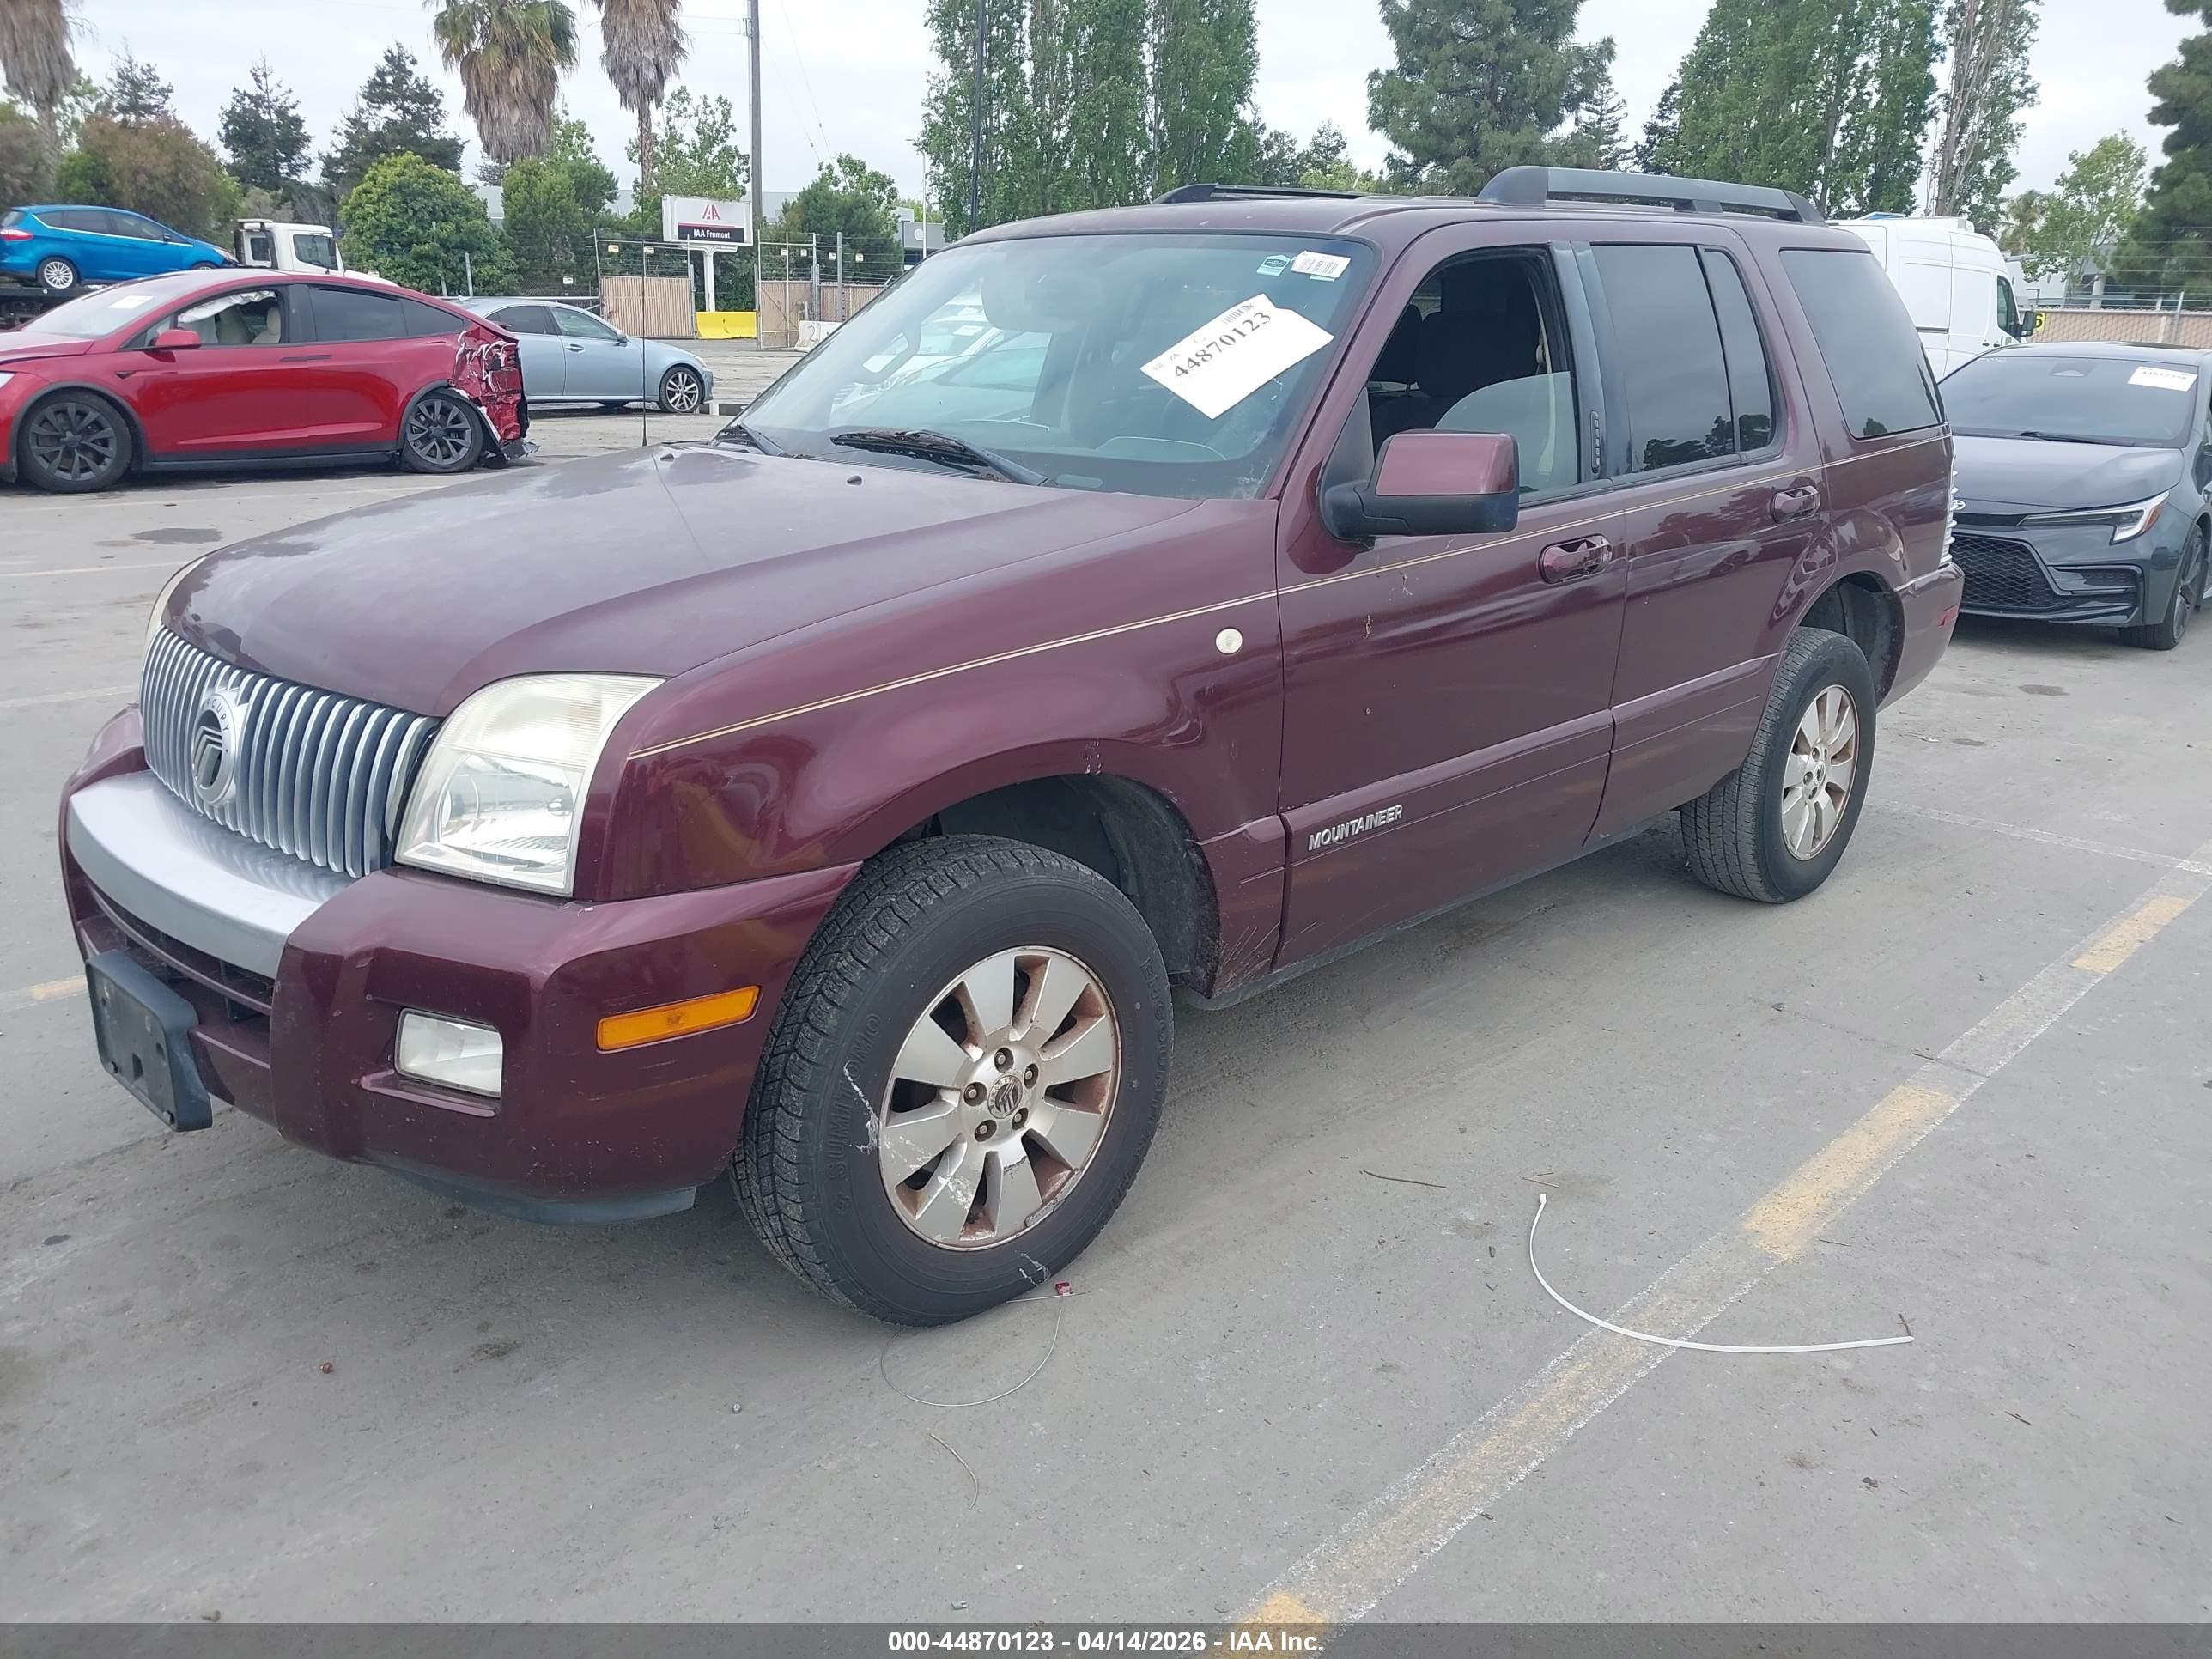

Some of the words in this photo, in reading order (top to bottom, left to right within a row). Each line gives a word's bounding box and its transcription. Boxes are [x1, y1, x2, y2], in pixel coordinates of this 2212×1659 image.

[693, 228, 705, 238] IAA
[706, 229, 731, 239] Fremont
[1176, 311, 1271, 377] 44870123
[1308, 805, 1403, 851] MOUNTAINEER
[827, 1012, 882, 1180] SUMITOMO
